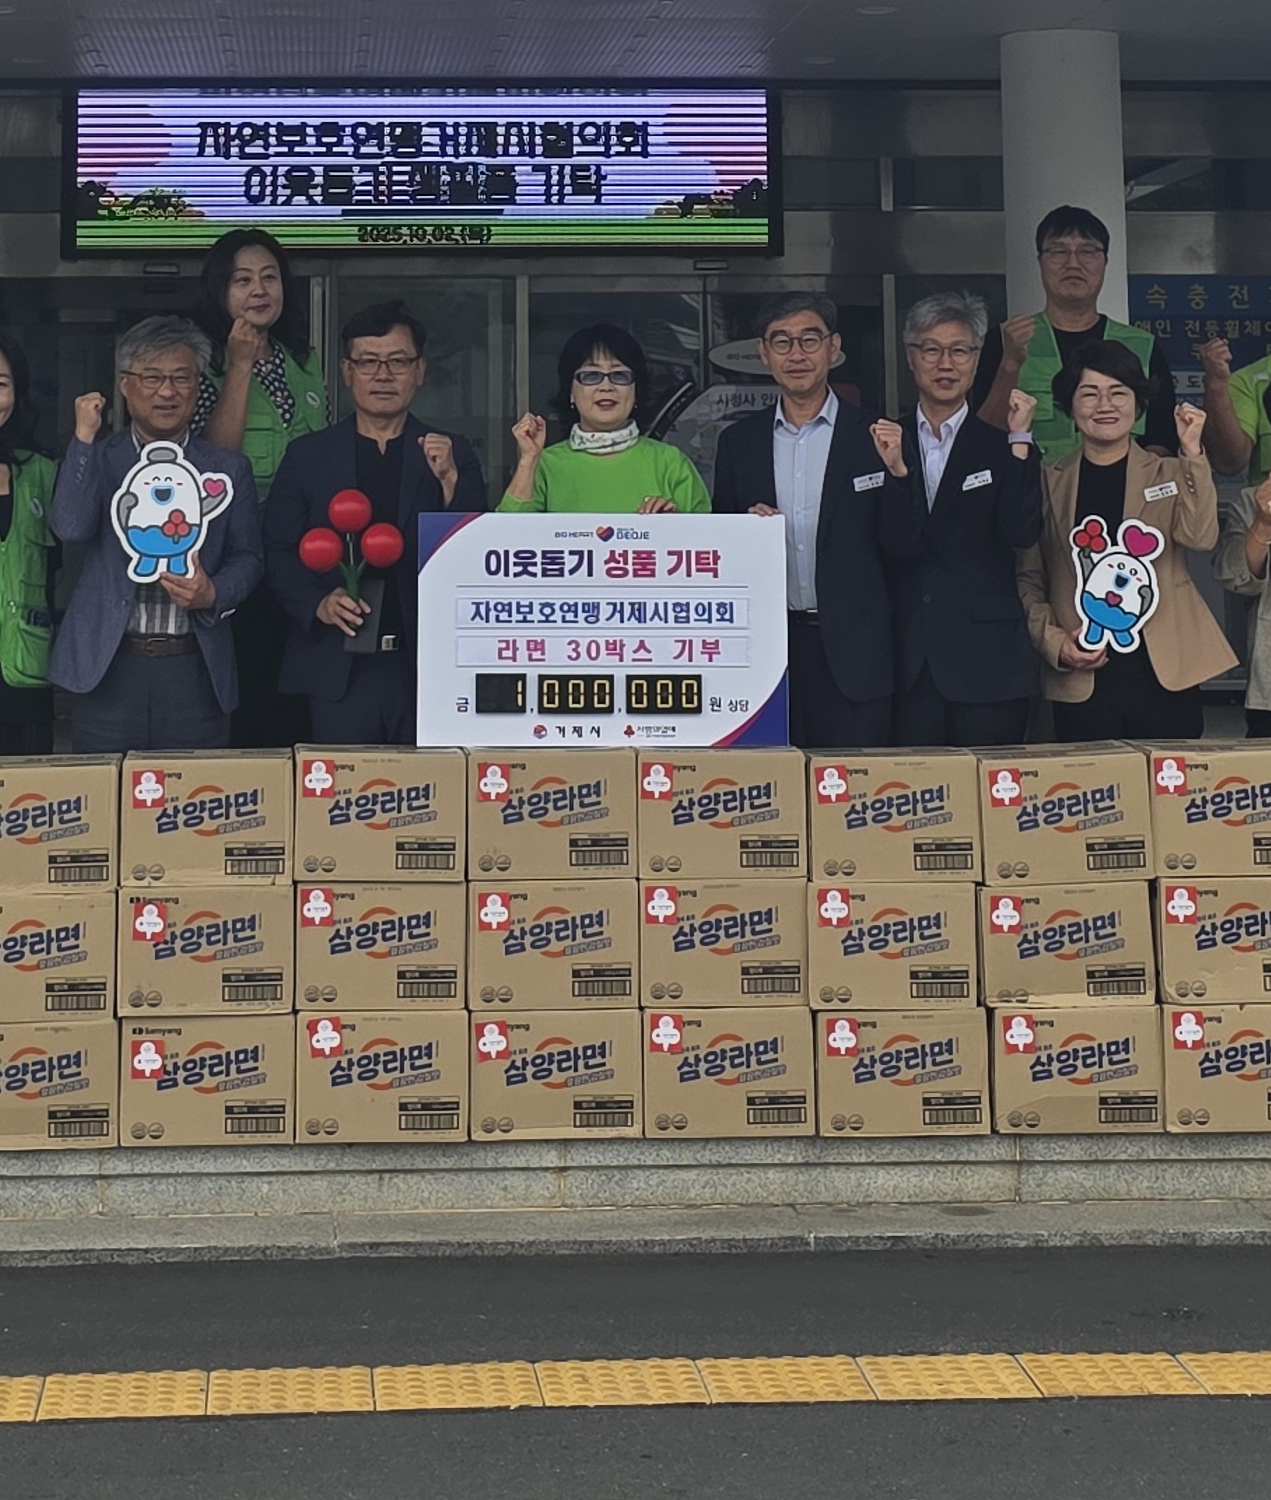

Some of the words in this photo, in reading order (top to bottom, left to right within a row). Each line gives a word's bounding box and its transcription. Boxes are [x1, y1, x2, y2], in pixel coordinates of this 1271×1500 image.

[484, 549, 594, 578] 이웃돕기
[603, 549, 656, 579] 성품
[666, 549, 721, 579] 기탁
[497, 638, 547, 663] 라면
[566, 638, 653, 663] 30박스
[673, 638, 722, 663] 기부
[455, 696, 469, 713] 금
[155, 788, 260, 834] 삼양라면
[327, 783, 432, 826] 삼양라면
[501, 779, 603, 825] 삼양라면
[672, 781, 774, 826] 삼양라면
[845, 785, 946, 830] 삼양라면
[1016, 784, 1117, 832] 삼양라면
[153, 914, 258, 961] 삼양라면
[328, 911, 433, 955] 삼양라면
[502, 909, 606, 955] 삼양라면
[672, 907, 775, 953] 삼양라면
[842, 912, 943, 957] 삼양라면
[1017, 911, 1118, 960] 삼양라면
[155, 1045, 261, 1092] 삼양라면
[330, 1041, 435, 1088] 삼양라면
[504, 1041, 609, 1086] 삼양라면
[677, 1036, 781, 1083] 삼양라면
[853, 1037, 956, 1084] 삼양라면
[1030, 1037, 1132, 1082] 삼양라면
